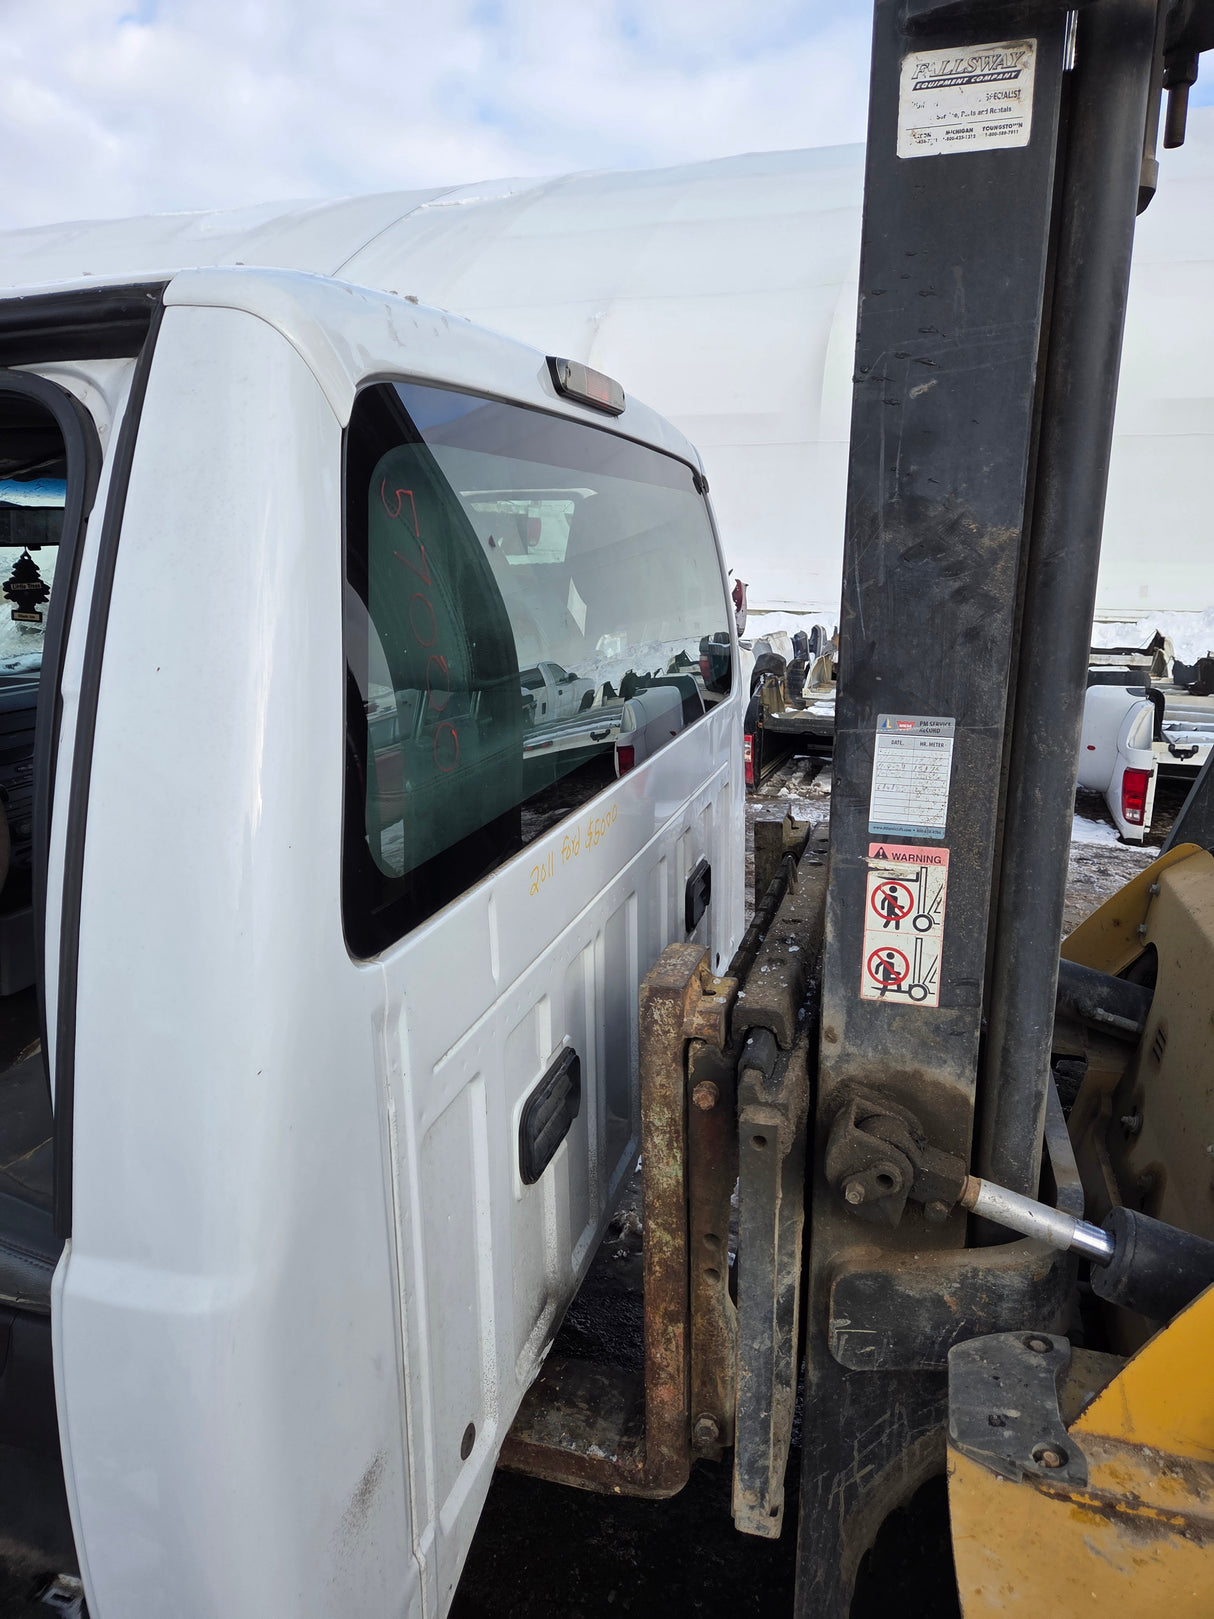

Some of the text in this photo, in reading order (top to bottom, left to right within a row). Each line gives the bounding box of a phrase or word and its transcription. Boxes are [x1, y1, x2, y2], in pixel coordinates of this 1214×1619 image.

[911, 51, 1026, 80] FALLSWAY
[915, 71, 1018, 89] EQUIPMENT COMPANY
[529, 851, 554, 896] 2011
[585, 804, 618, 852] $5000
[891, 852, 942, 865] WARNING
